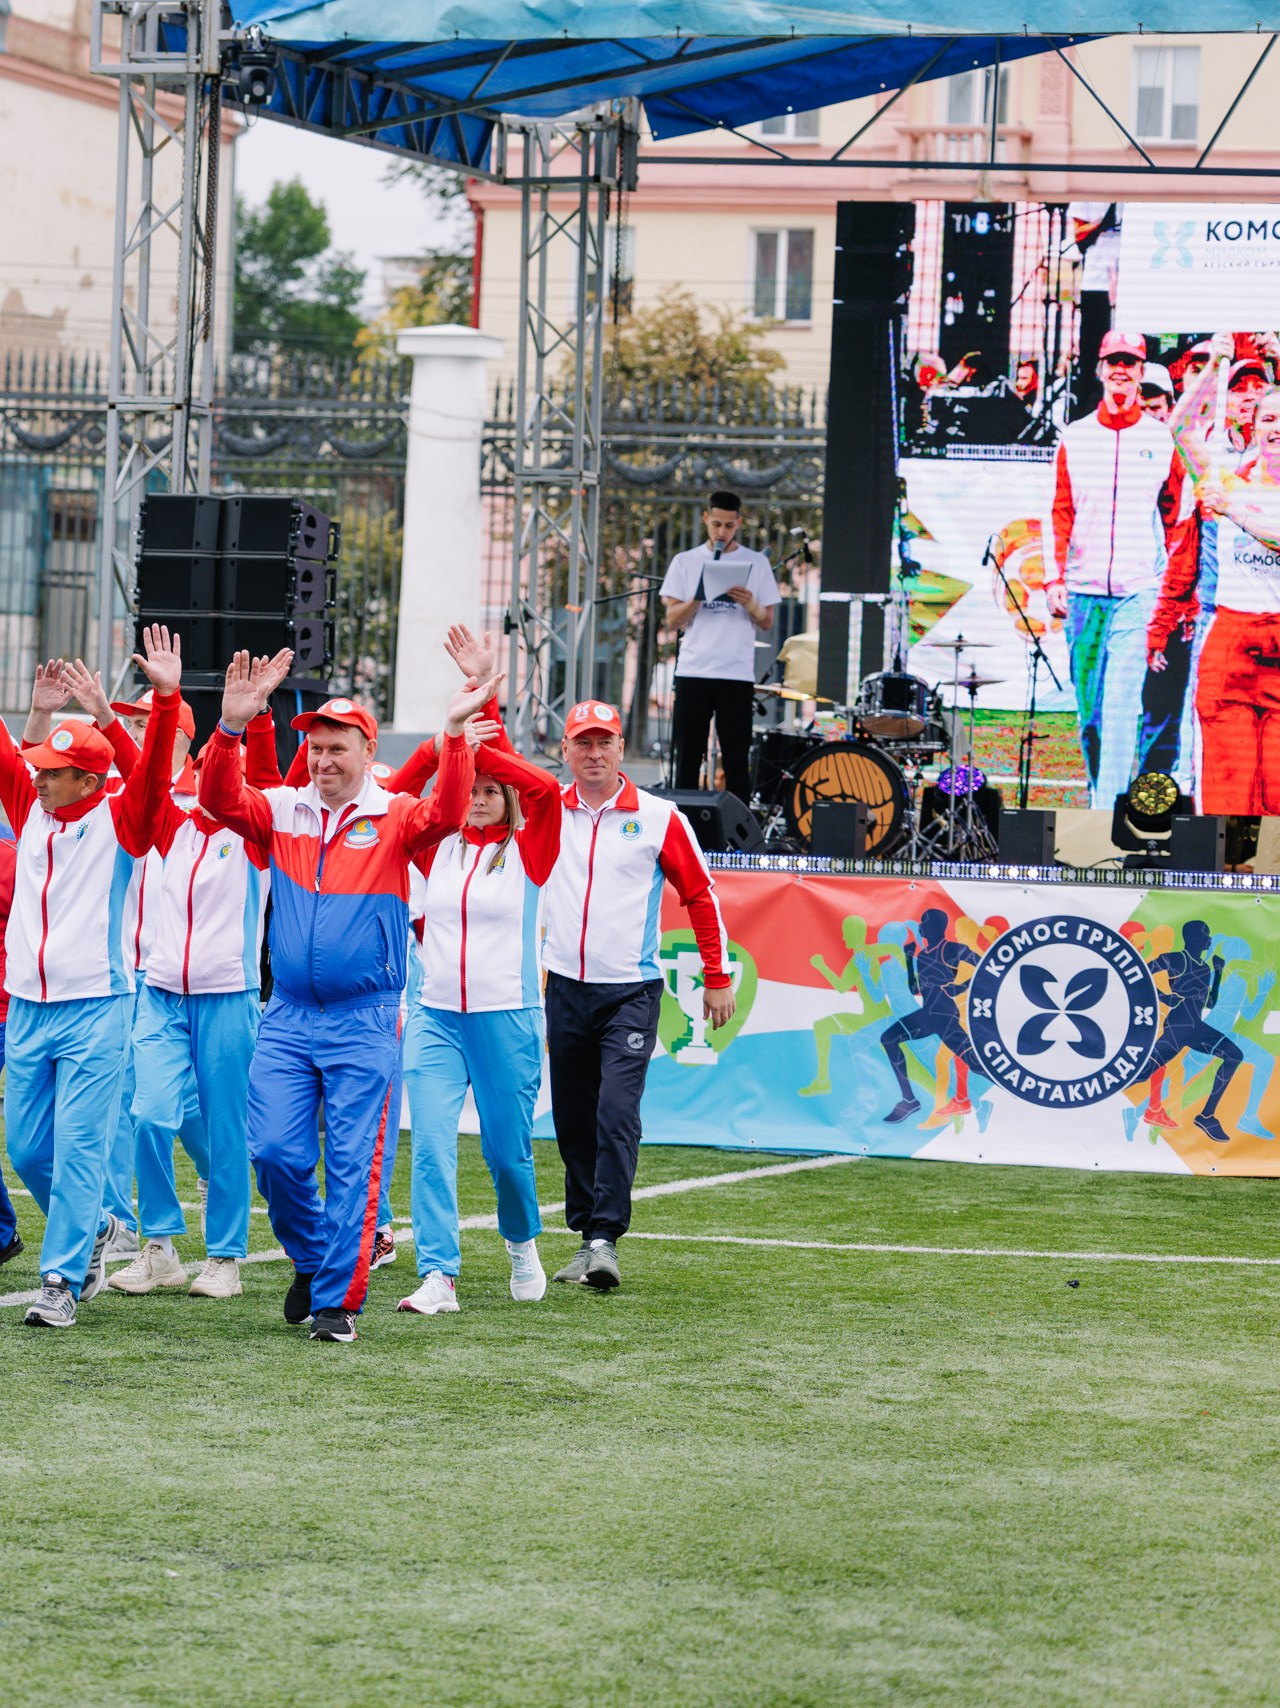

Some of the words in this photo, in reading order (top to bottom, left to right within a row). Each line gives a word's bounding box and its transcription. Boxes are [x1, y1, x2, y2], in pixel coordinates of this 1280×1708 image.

[985, 921, 1068, 978] КОМОС
[1076, 923, 1144, 985] ГРУПП
[983, 1041, 1144, 1102] СПАРТАКИАДА
